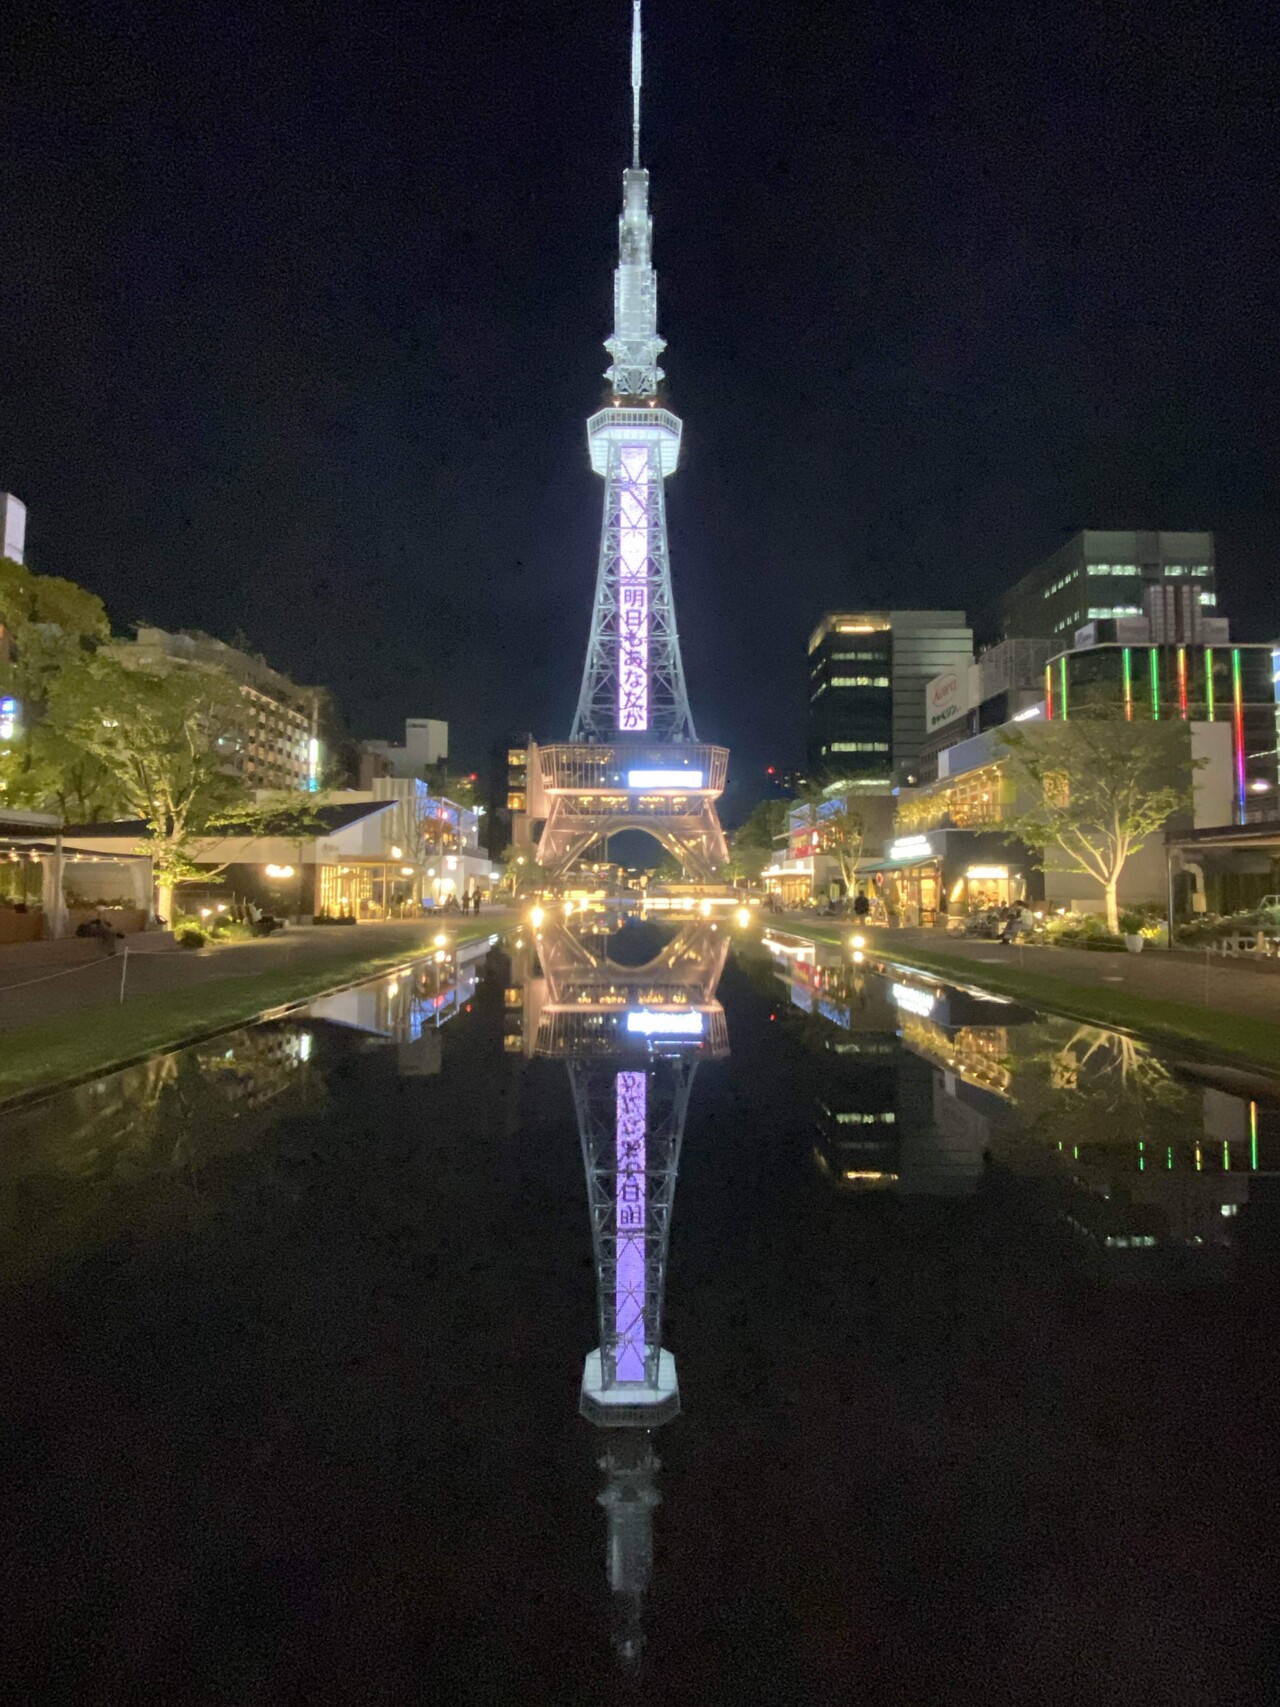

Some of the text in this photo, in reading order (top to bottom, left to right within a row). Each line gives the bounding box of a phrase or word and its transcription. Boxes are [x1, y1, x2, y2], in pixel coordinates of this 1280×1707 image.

[623, 588, 644, 728] 明日もあなたが
